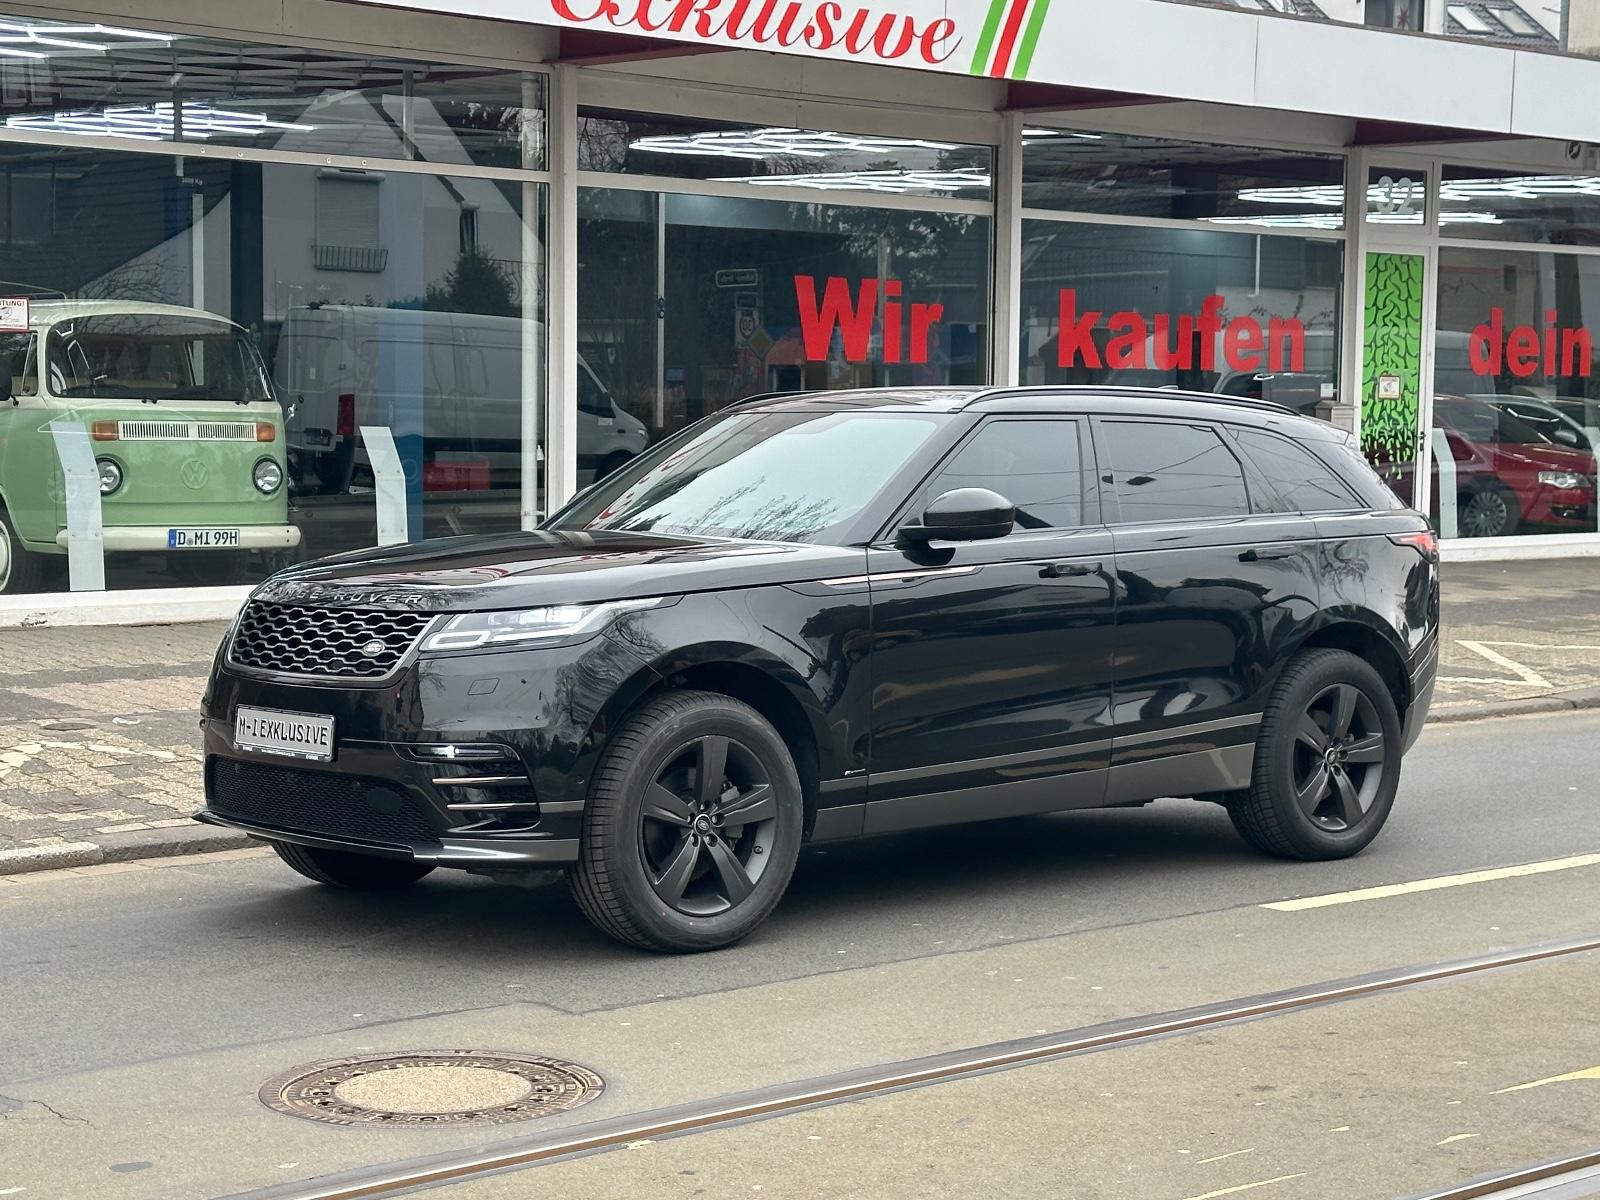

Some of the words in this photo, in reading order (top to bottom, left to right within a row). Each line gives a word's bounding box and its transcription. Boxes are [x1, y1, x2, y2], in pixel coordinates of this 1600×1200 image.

[1376, 175, 1414, 214] 32
[795, 275, 943, 364] Wir
[1057, 288, 1305, 374] kaufen
[1469, 308, 1592, 377] dein
[177, 531, 186, 545] D
[194, 531, 210, 545] MI
[213, 531, 237, 545] 99H
[334, 593, 423, 604] ROVER
